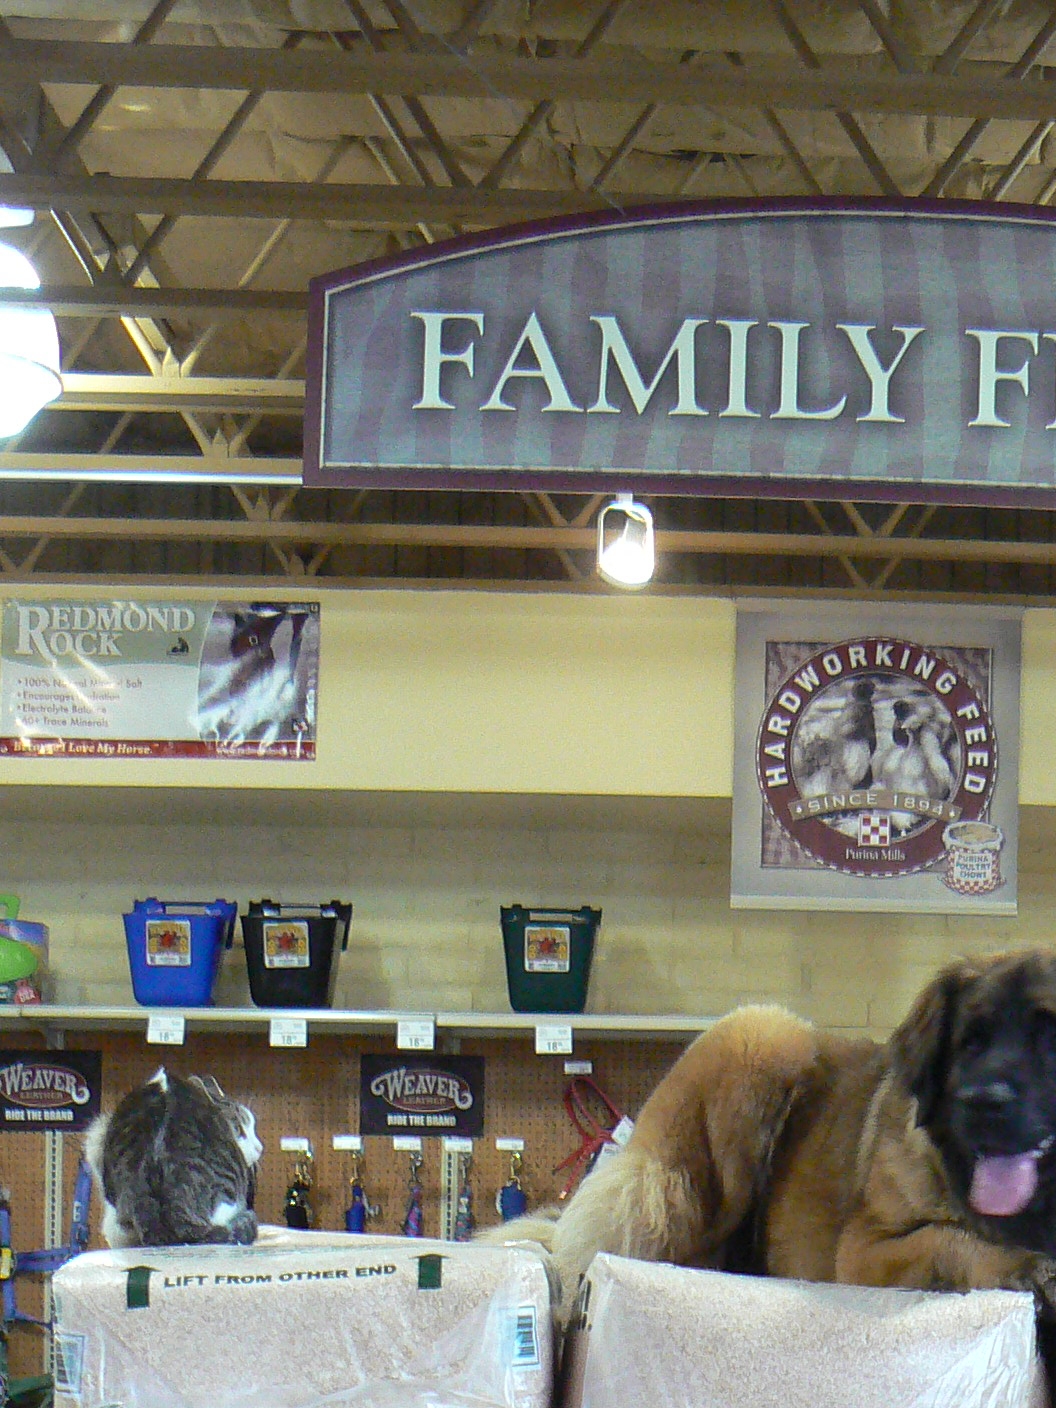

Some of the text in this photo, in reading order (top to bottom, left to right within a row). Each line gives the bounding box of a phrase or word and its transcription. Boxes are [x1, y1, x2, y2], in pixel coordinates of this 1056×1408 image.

[410, 310, 925, 423] FAMILY
[15, 604, 195, 655] REDMOND
[70, 716, 109, 728] Minerals
[764, 641, 989, 795] HARDWORKING FEED
[69, 742, 95, 753] Love
[97, 743, 115, 755] My
[806, 792, 945, 816] SINCE 1894
[845, 847, 906, 861] Purina Mills
[0, 1063, 90, 1105] WEAVER
[371, 1067, 473, 1111] WEAVER
[409, 1113, 425, 1126] THE
[164, 1264, 397, 1288] LIFT FROM OTHER END
